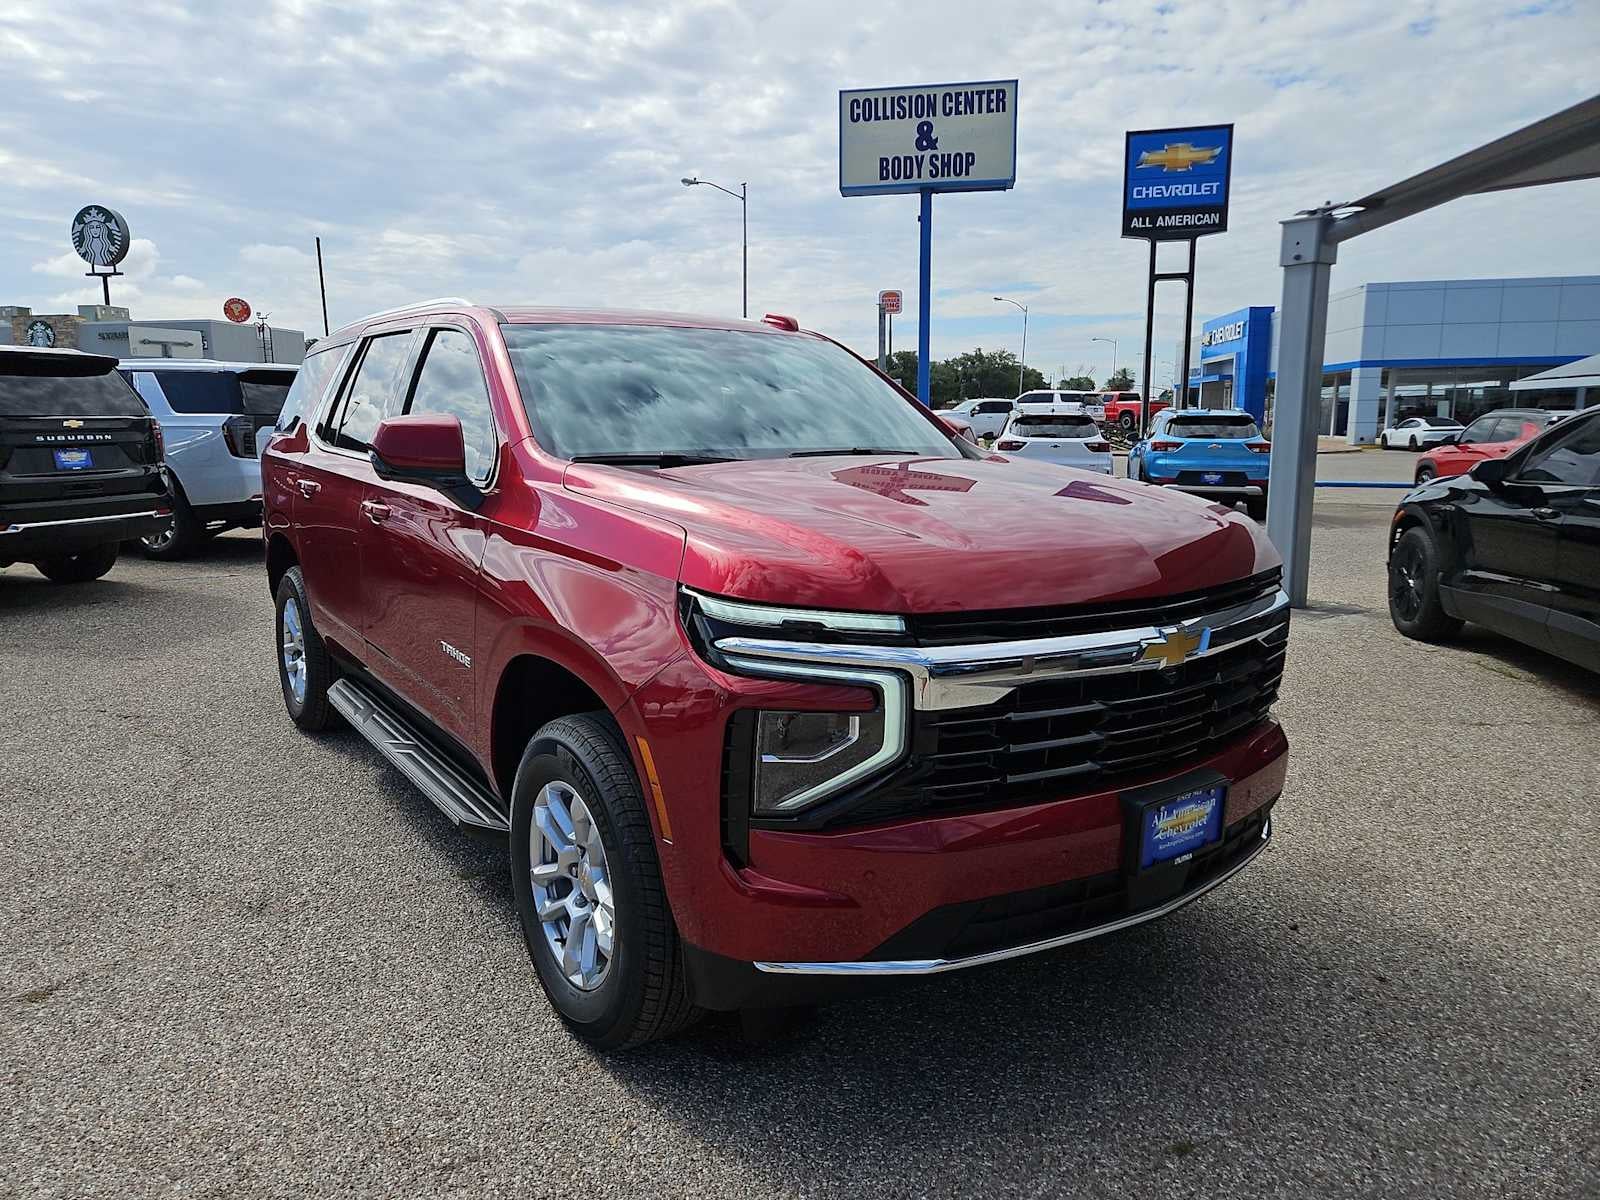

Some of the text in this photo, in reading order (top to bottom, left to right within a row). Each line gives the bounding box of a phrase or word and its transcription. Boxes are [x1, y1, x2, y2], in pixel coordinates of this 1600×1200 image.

[850, 88, 1007, 123] COLLISION CENTER
[915, 120, 939, 151] &
[879, 152, 976, 181] BODY SHOP
[1133, 182, 1220, 199] CHEVROLET
[1130, 213, 1220, 228] ALL AMERICAN
[1212, 321, 1244, 345] CHEVROLET
[35, 434, 112, 442] SUBURBAN
[440, 640, 471, 668] TAHOE
[1151, 798, 1216, 828] All American
[1159, 815, 1208, 840] Chevrolet
